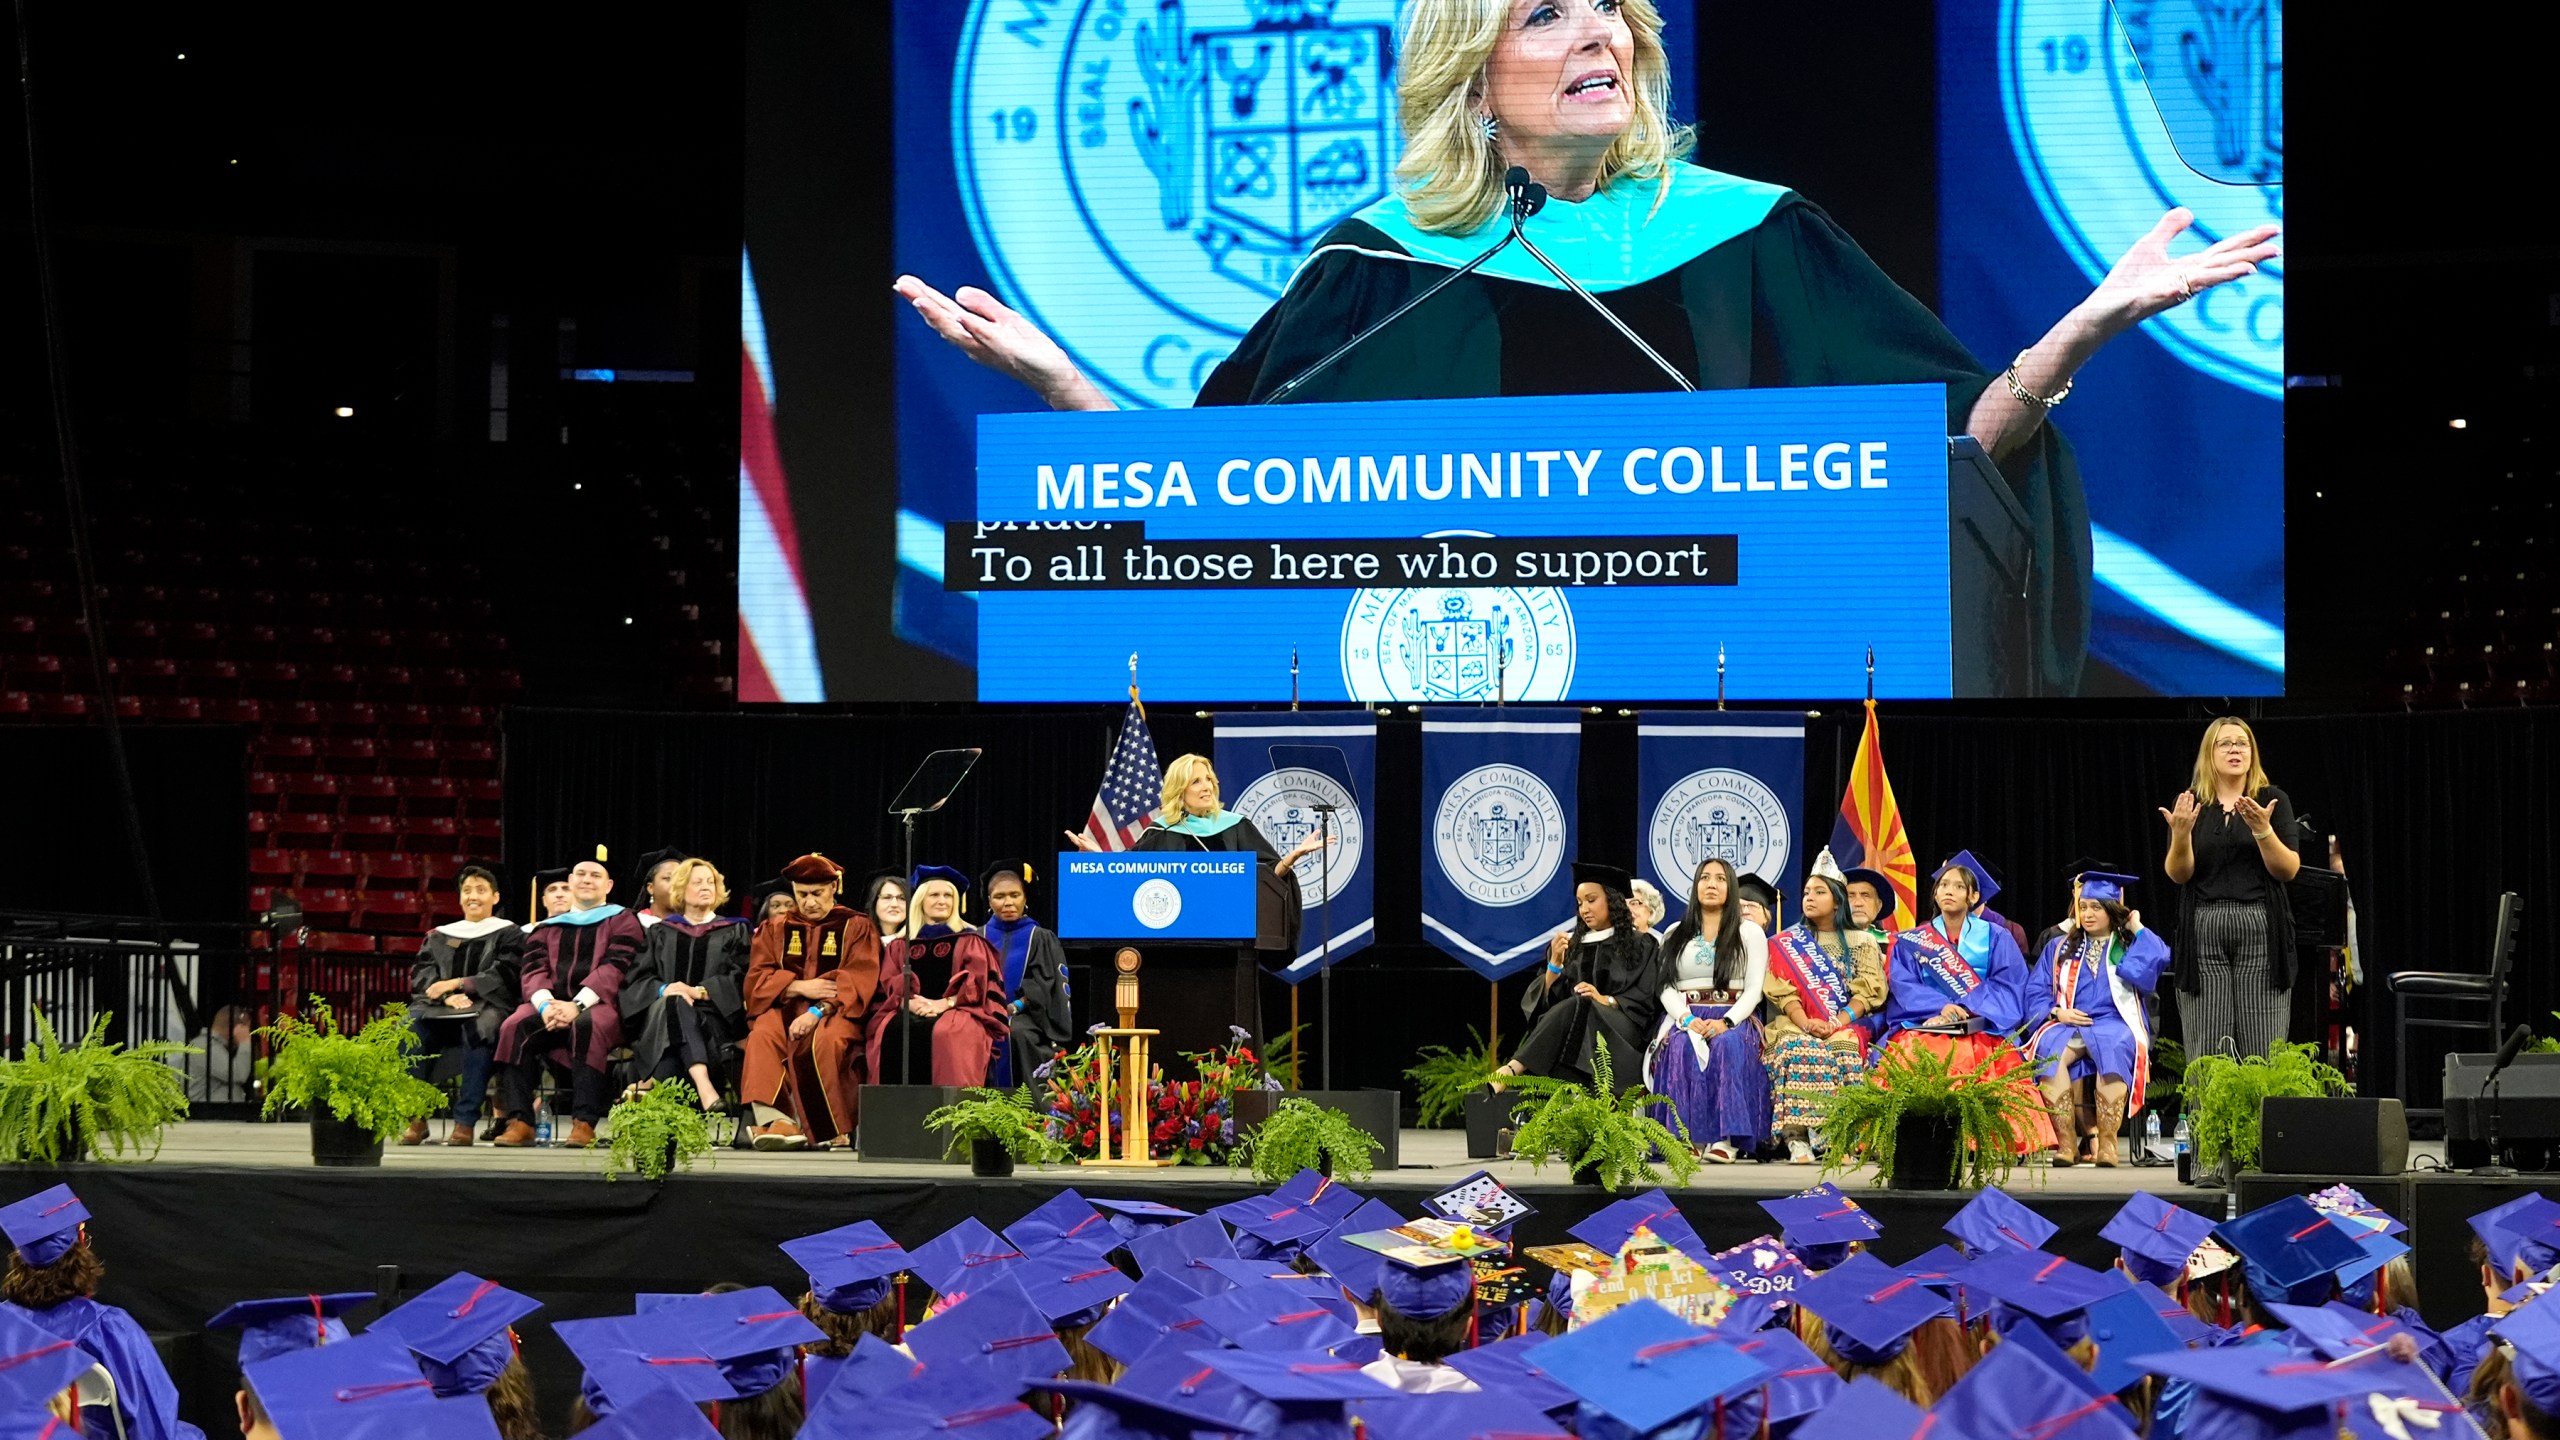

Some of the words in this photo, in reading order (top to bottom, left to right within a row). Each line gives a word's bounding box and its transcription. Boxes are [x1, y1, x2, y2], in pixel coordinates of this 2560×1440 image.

[2038, 35, 2090, 74] 19
[992, 107, 1038, 143] 19
[1037, 461, 1198, 510] MESA
[1217, 450, 1603, 506] COMMUNITY
[1623, 442, 1888, 496] COLLEGE
[972, 547, 1032, 582] To
[1049, 546, 1106, 581] all
[1123, 545, 1254, 581] those
[1270, 544, 1380, 580] here
[1398, 543, 1497, 579] who
[1515, 543, 1708, 585] support
[1353, 648, 1370, 659] 19
[1382, 631, 1392, 665] SEAL
[1388, 611, 1399, 627] OF
[1515, 606, 1533, 662] ARIZONA
[1545, 644, 1564, 656] 65
[1240, 789, 1265, 818] ESA
[1273, 776, 1356, 827] COMMUNITY
[1262, 792, 1298, 814] MARICOPA
[1443, 785, 1471, 821] MESA
[1479, 772, 1557, 824] COMMUNITY
[1660, 789, 1689, 826] MESA
[1697, 776, 1782, 829] COMMUNITY
[1460, 810, 1468, 821] OF
[1468, 789, 1502, 809] MARICOPA
[1504, 790, 1531, 809] COUNTY
[1530, 811, 1541, 844] ARIZONA
[1674, 828, 1682, 848] SEAL
[1679, 815, 1686, 825] OF
[1686, 794, 1723, 814] MARICOPA
[1725, 795, 1755, 814] COUNTY
[1753, 815, 1765, 849] ARIZONA
[1346, 836, 1358, 845] 65
[1441, 832, 1451, 841] 19
[1547, 834, 1559, 842] 65
[1657, 837, 1667, 846] 19
[1772, 839, 1783, 847] 65
[1070, 862, 1104, 874] MESA
[1108, 862, 1187, 874] COMMUNITY
[1190, 862, 1246, 874] COLLEGE
[1468, 880, 1529, 899] COLLEGE
[1779, 936, 1822, 989] Community
[1898, 931, 1945, 952] Attendant
[1938, 947, 1963, 973] Miss
[1802, 941, 1829, 972] Native
[1823, 972, 1847, 1003] Mesa
[1491, 1286, 1510, 1294] THE
[1599, 1275, 1625, 1294] end
[1644, 1271, 1658, 1287] of
[1671, 1270, 1694, 1285] Act
